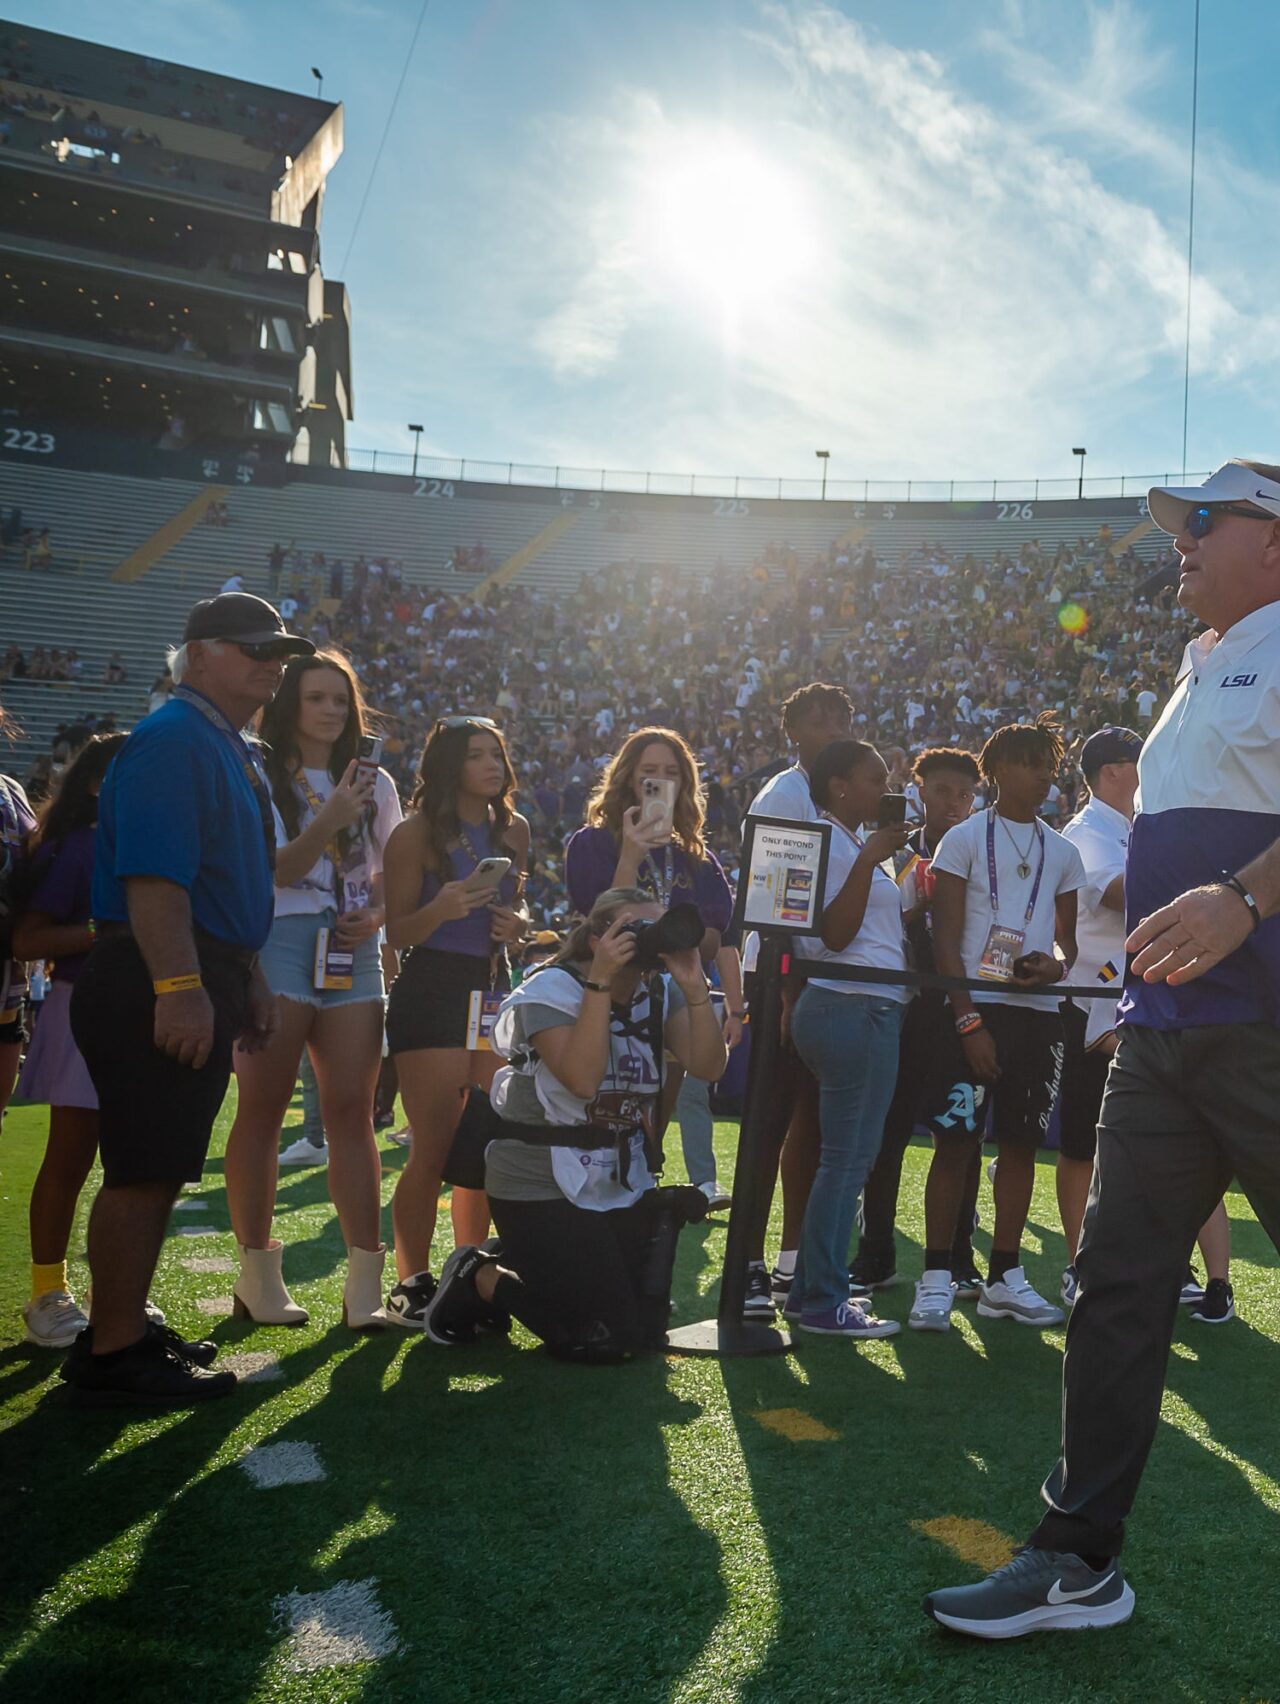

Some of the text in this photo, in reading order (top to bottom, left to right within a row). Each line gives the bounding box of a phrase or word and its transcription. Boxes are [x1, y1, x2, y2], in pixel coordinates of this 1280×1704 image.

[3, 428, 55, 453] 223
[414, 478, 455, 499] 224
[713, 500, 750, 517] 225
[996, 503, 1034, 521] 226
[1220, 673, 1258, 688] LSU
[762, 836, 814, 849] ONLY BEYOND
[766, 850, 807, 861] THIS POINT
